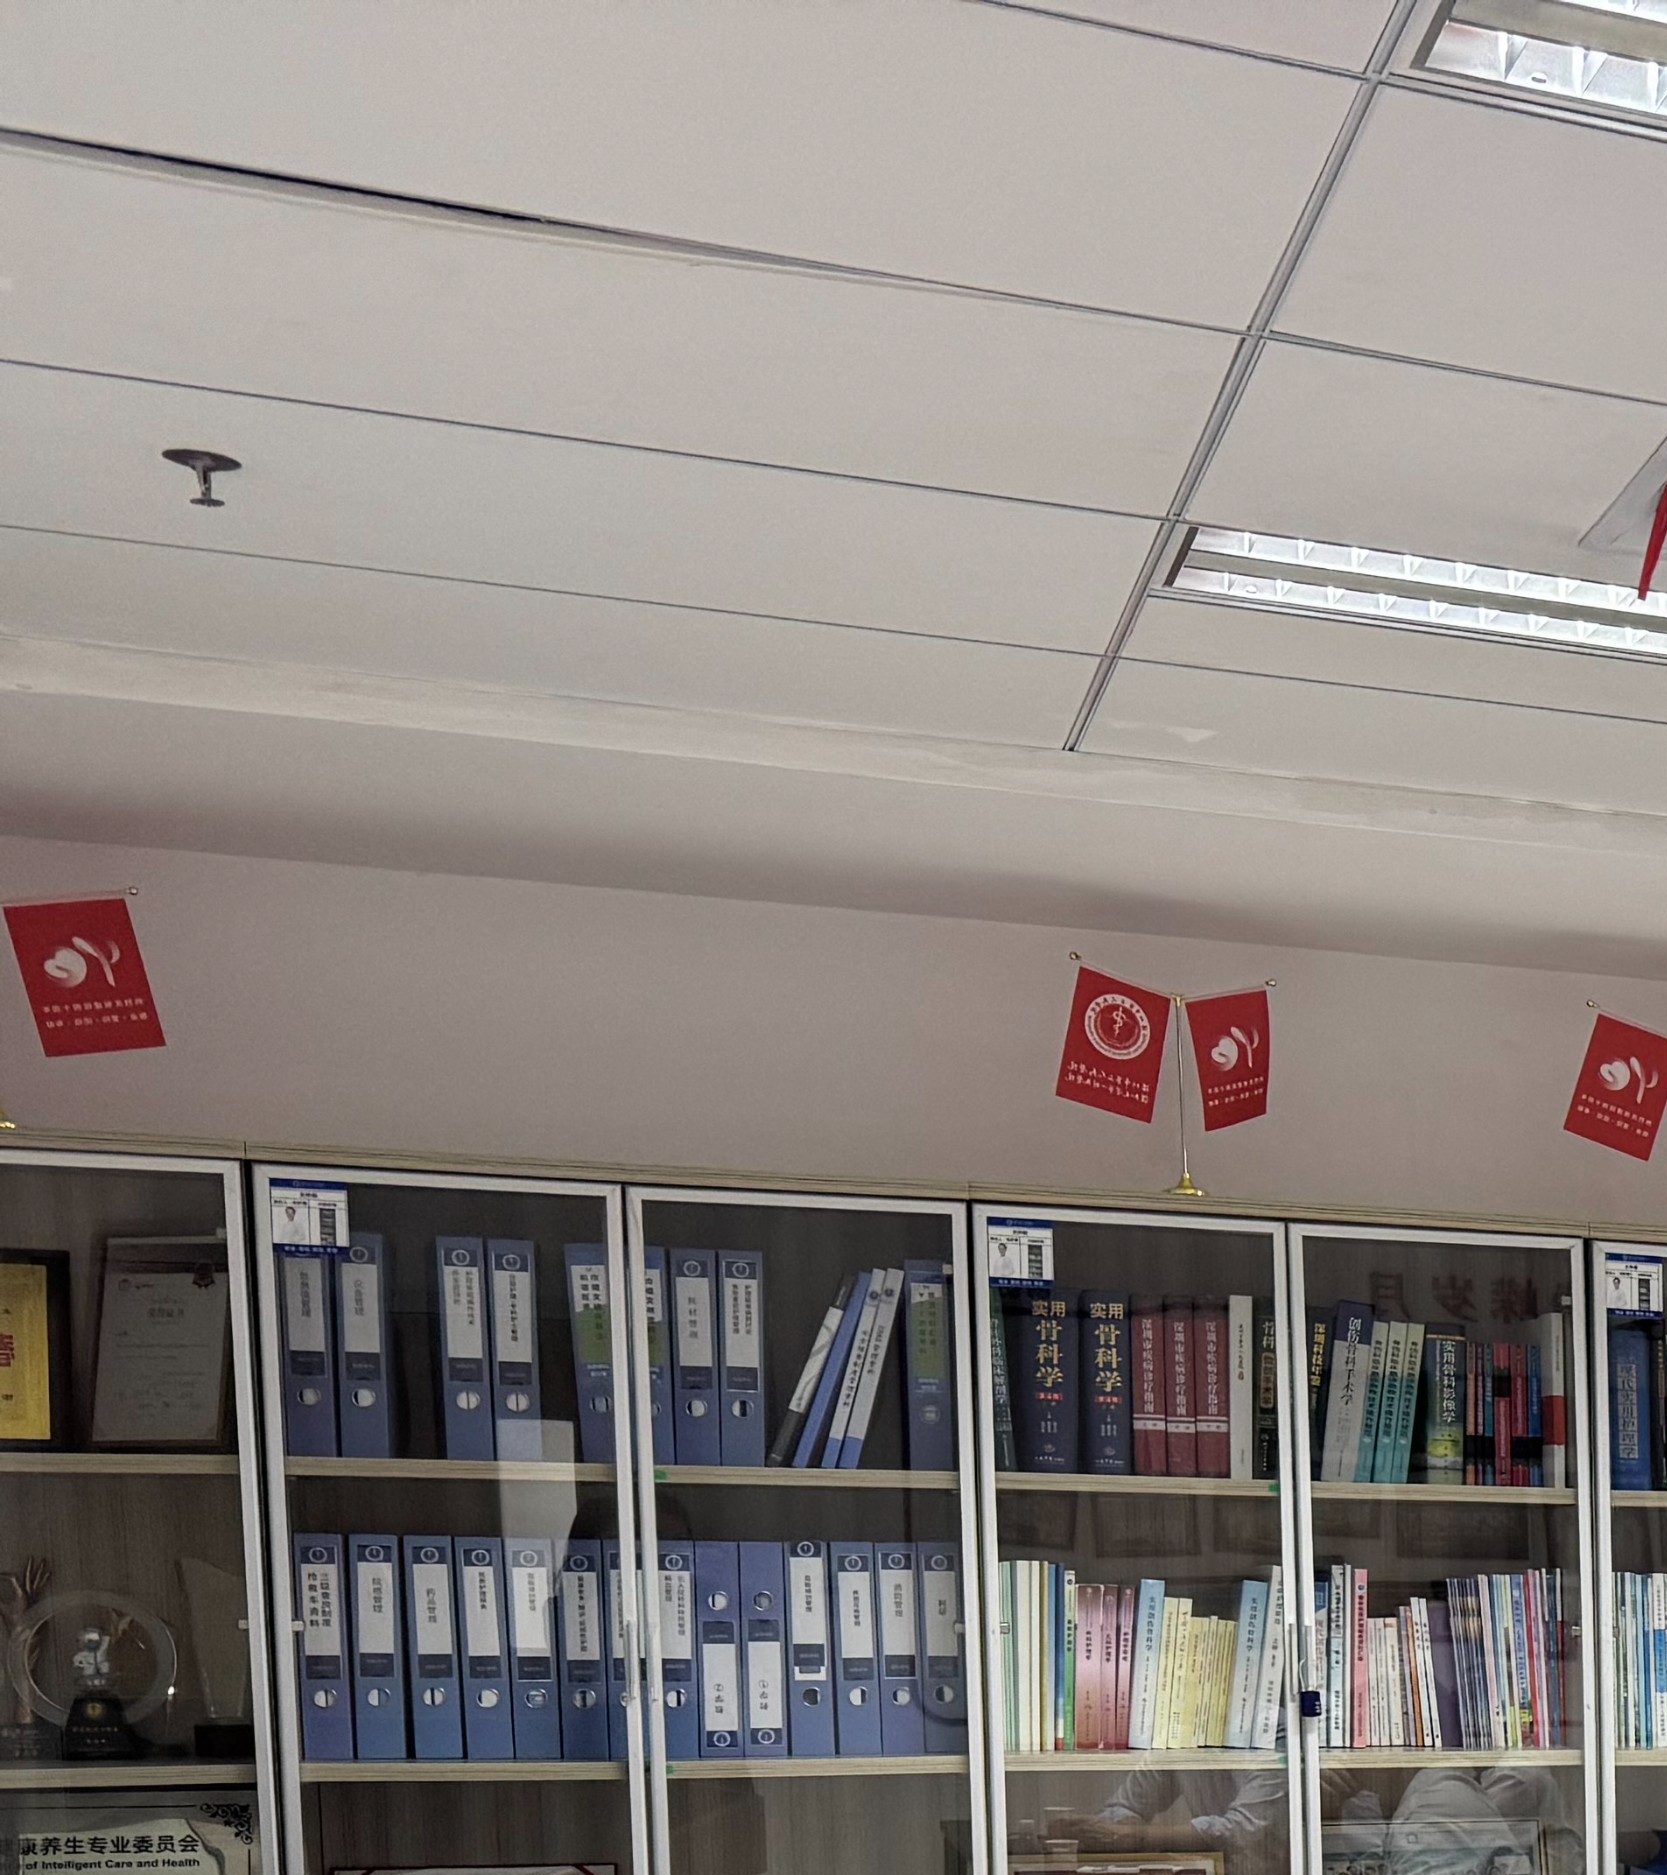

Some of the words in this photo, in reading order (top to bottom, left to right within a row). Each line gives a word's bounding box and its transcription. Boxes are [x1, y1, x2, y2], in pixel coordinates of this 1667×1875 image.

[1032, 1300, 1067, 1318] 实用
[1090, 1302, 1124, 1320] 实用
[1035, 1320, 1064, 1388] 骨科学
[1094, 1323, 1123, 1393] 骨科学
[1441, 1340, 1457, 1423] 实用骨科影像学
[25, 1858, 38, 1871] of
[41, 1858, 102, 1871] Intelligent
[105, 1858, 134, 1870] Care
[136, 1858, 159, 1869] and
[161, 1857, 200, 1869] Health
